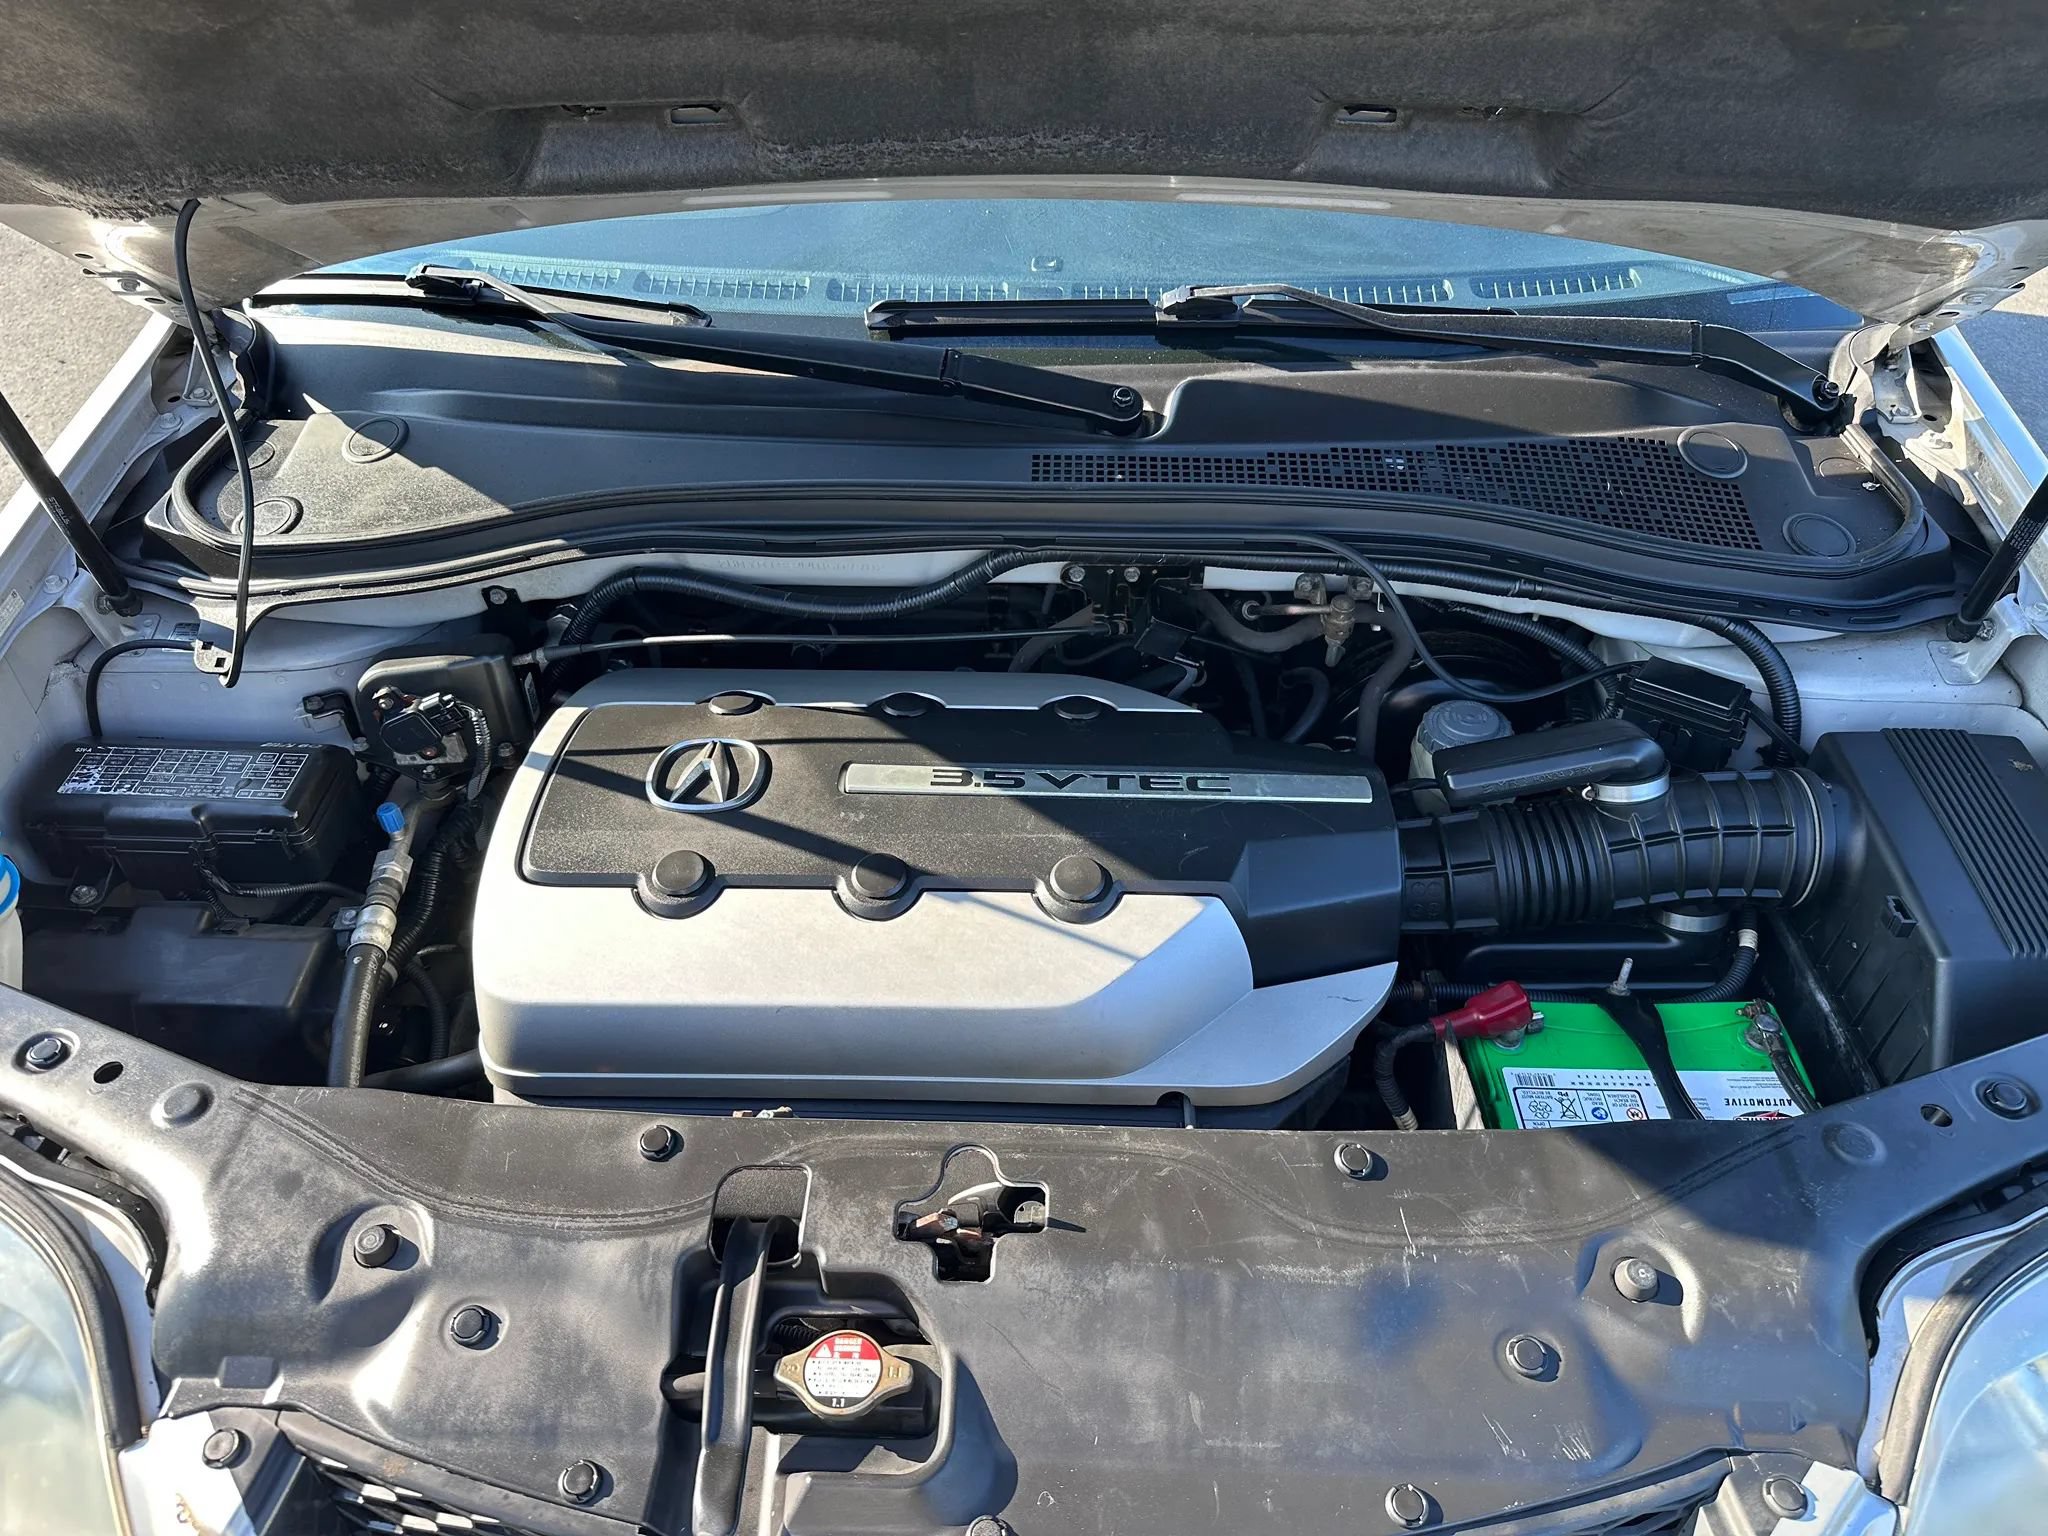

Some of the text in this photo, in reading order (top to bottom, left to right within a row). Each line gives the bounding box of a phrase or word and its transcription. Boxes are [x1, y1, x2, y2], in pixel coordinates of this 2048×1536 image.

[931, 768, 1232, 793] 3.5 VTEC
[1724, 1097, 1792, 1107] AUTOMOTIVE
[831, 1397, 845, 1407] 1.1
